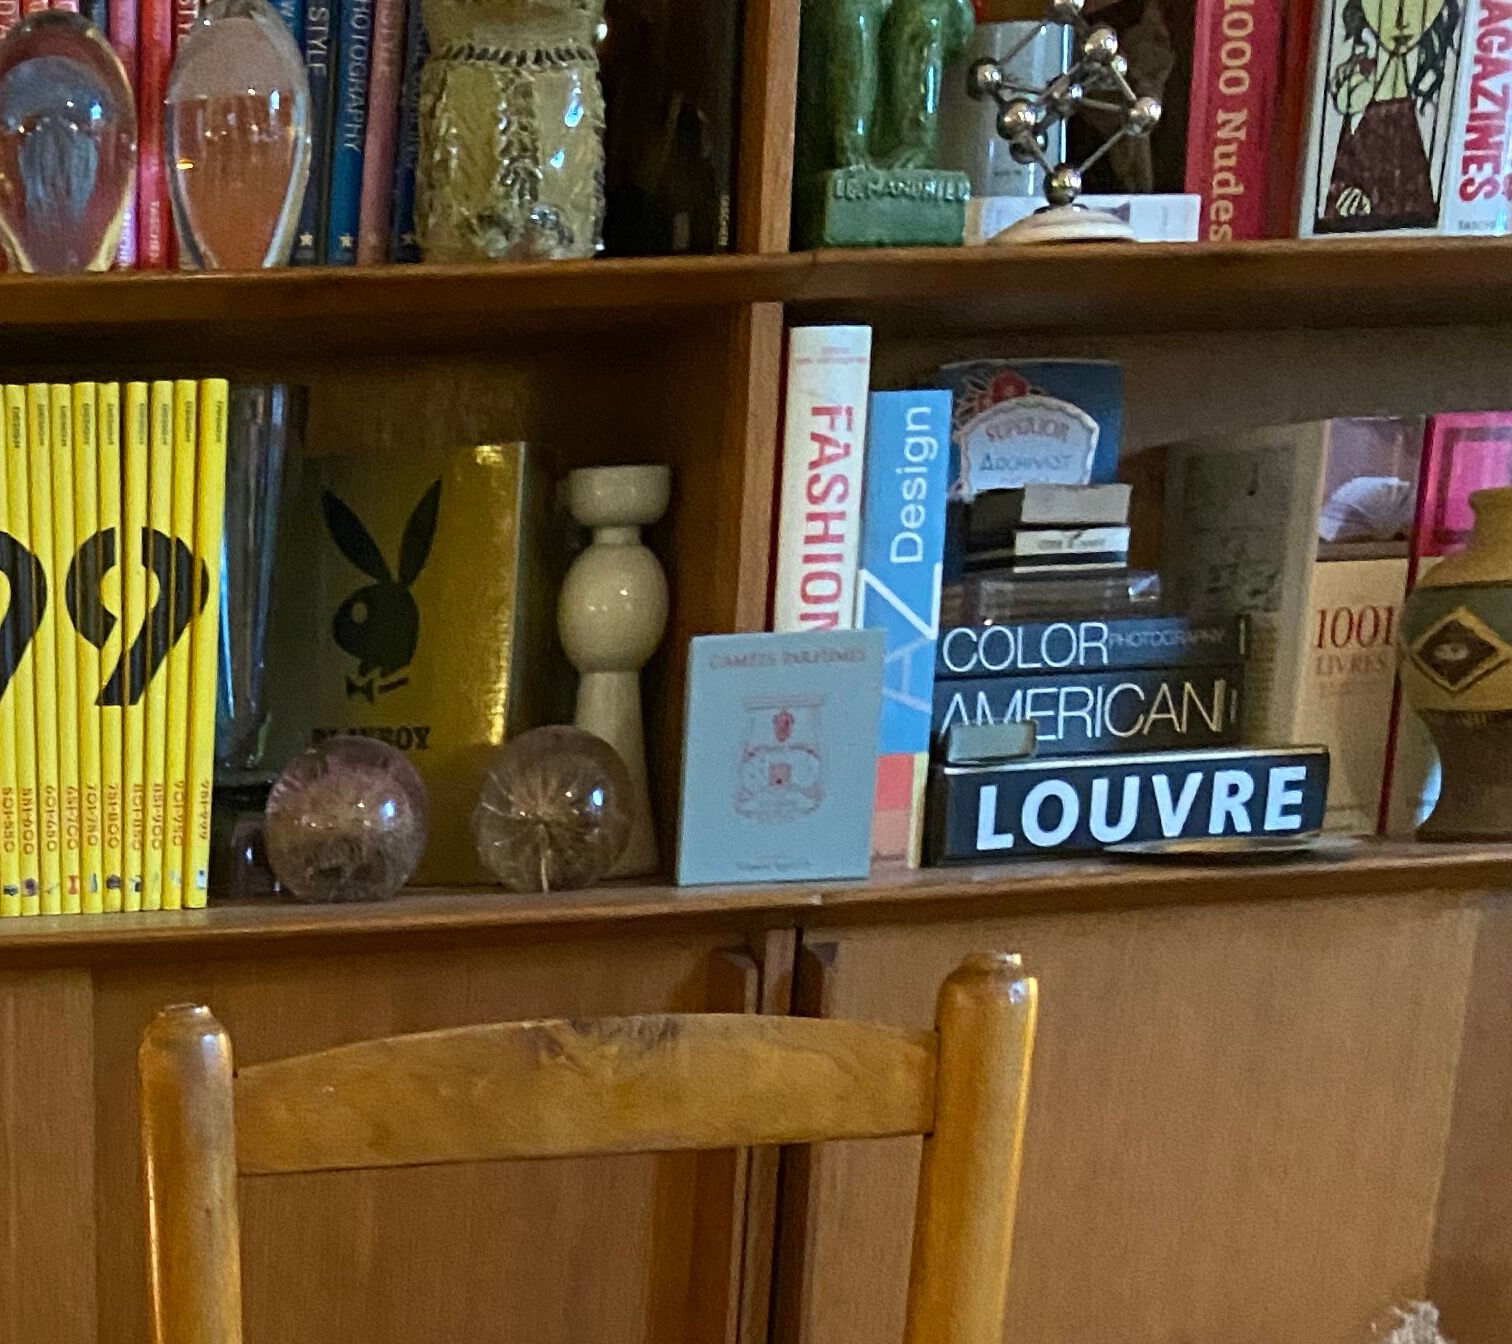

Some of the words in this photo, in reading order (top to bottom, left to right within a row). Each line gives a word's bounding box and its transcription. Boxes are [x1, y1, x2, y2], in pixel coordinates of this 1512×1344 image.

[1209, 109, 1250, 242] Nudes
[890, 403, 934, 564] Design
[941, 621, 1109, 674] COLOR
[1316, 605, 1395, 649] 1001
[939, 679, 1226, 744] AMERICAN
[974, 764, 1307, 852] LOUVRE
